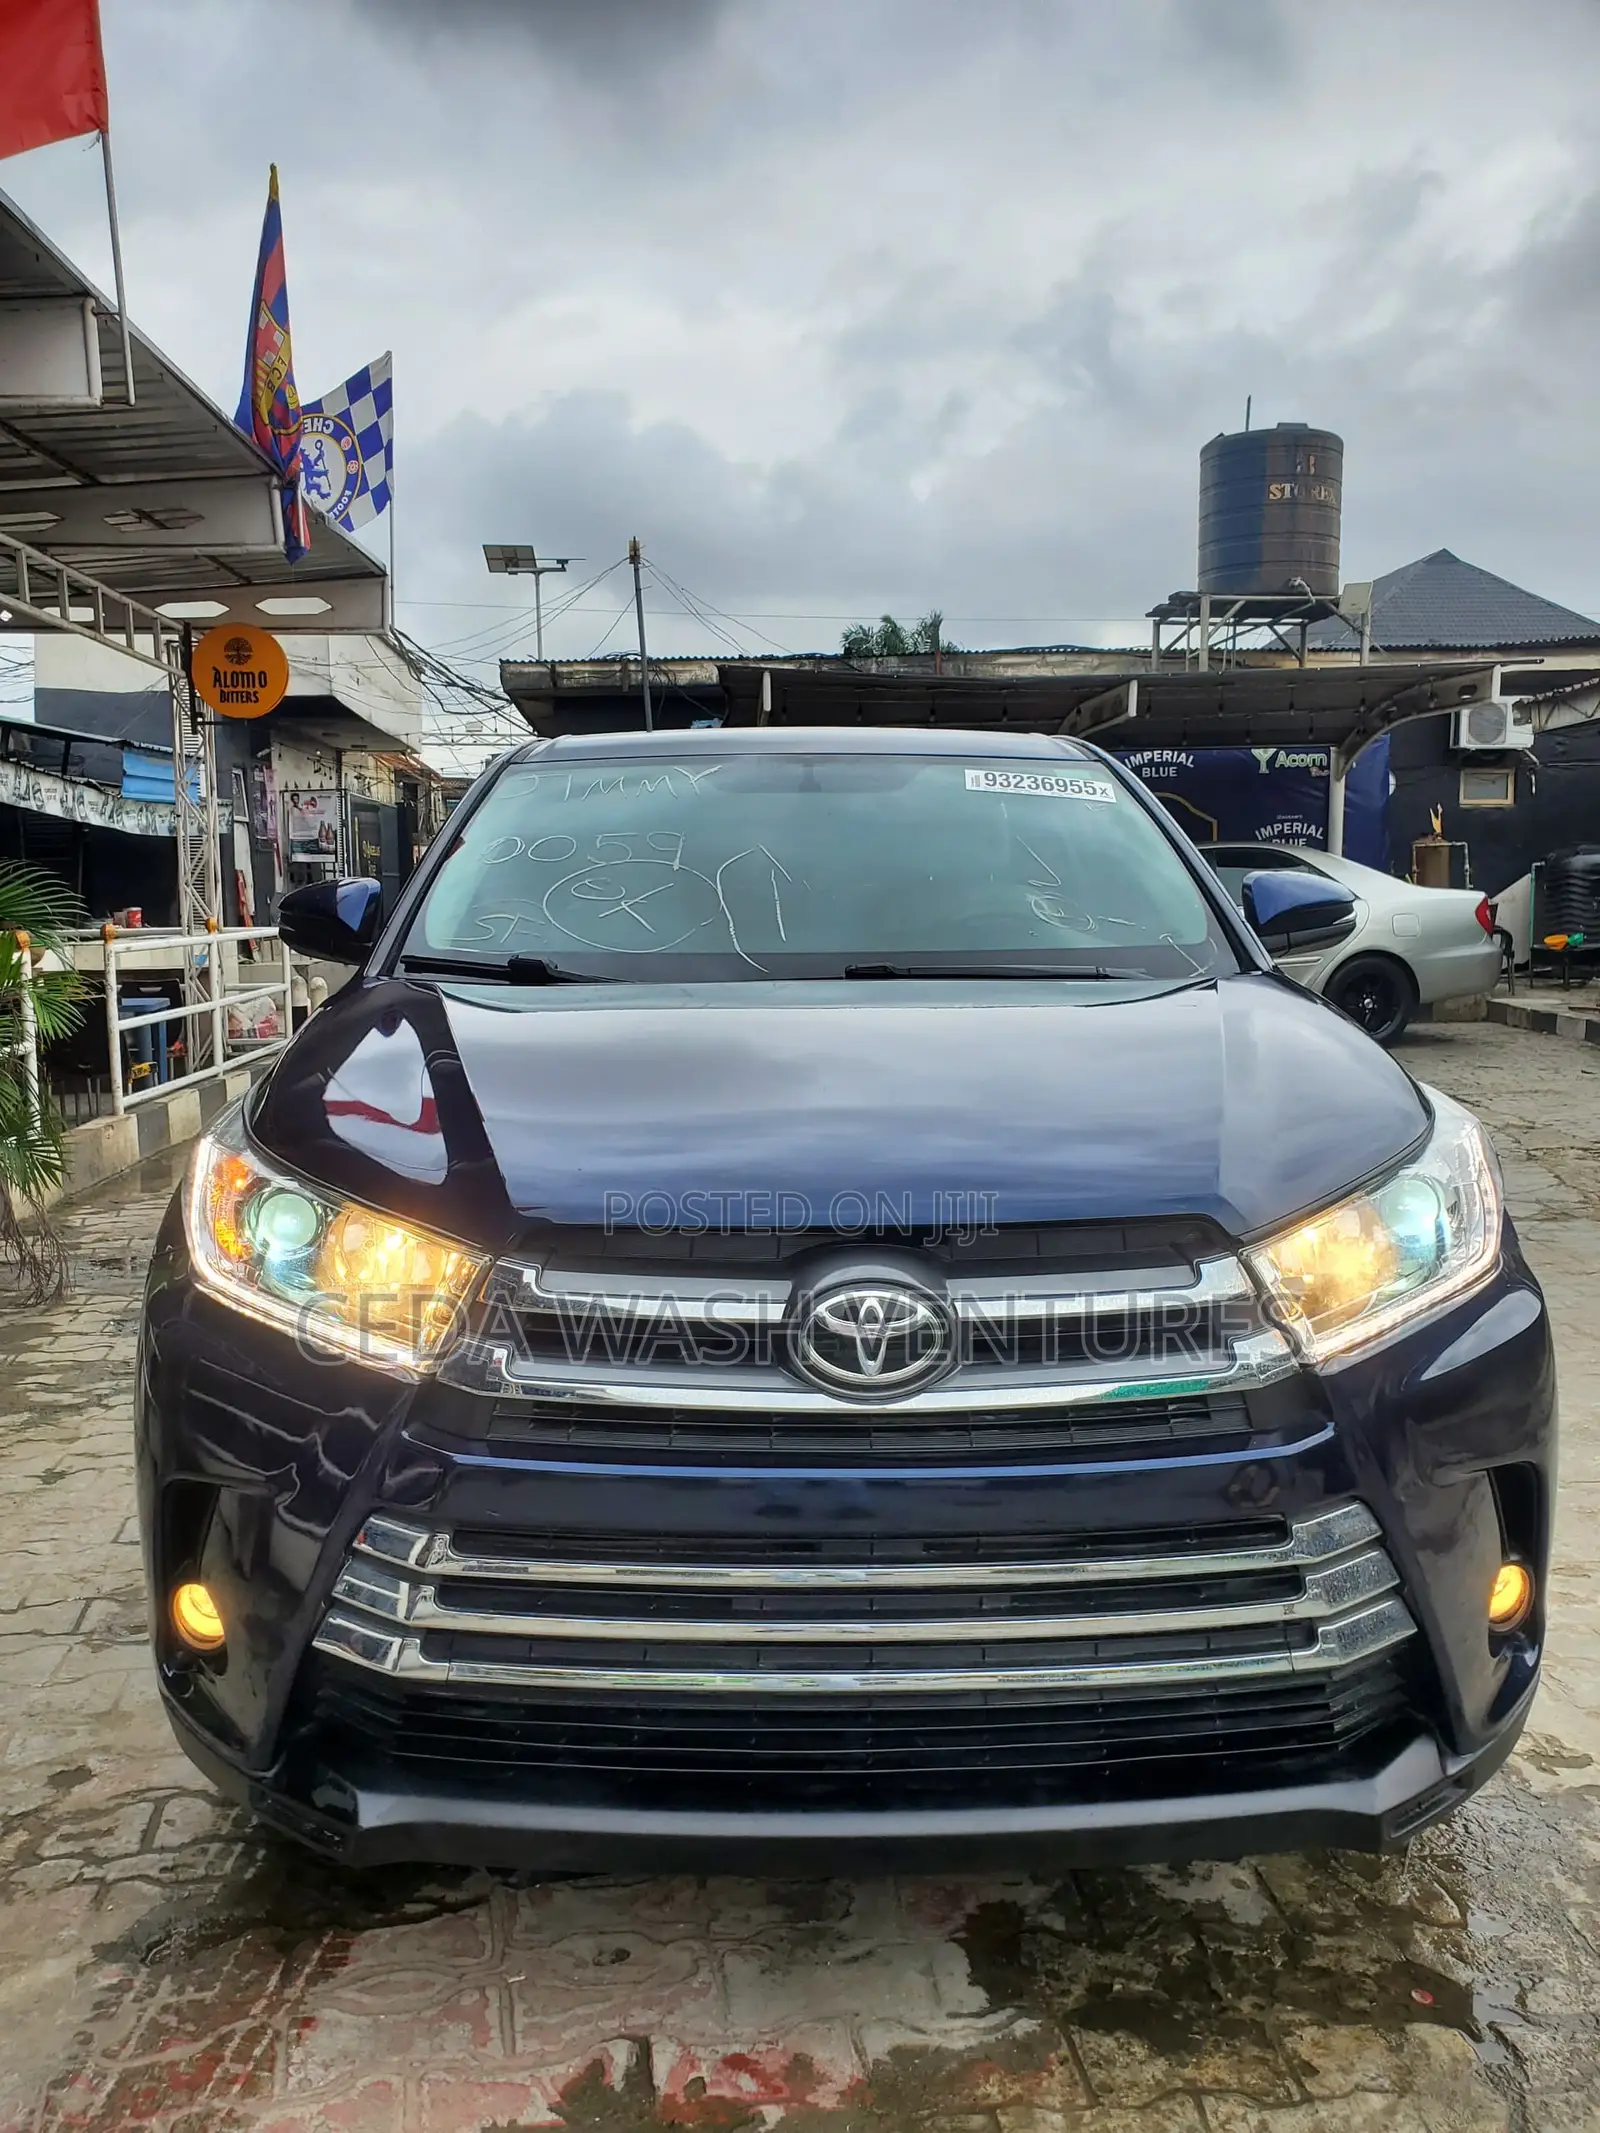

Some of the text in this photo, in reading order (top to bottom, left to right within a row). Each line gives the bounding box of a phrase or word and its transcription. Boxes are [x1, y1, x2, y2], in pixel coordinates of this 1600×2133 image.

[1124, 750, 1195, 769] IMPERIAL
[1274, 750, 1328, 768] Acorn
[1142, 766, 1178, 778] BLUE
[1255, 822, 1324, 840] IMPERIAL
[481, 831, 686, 871] 0059
